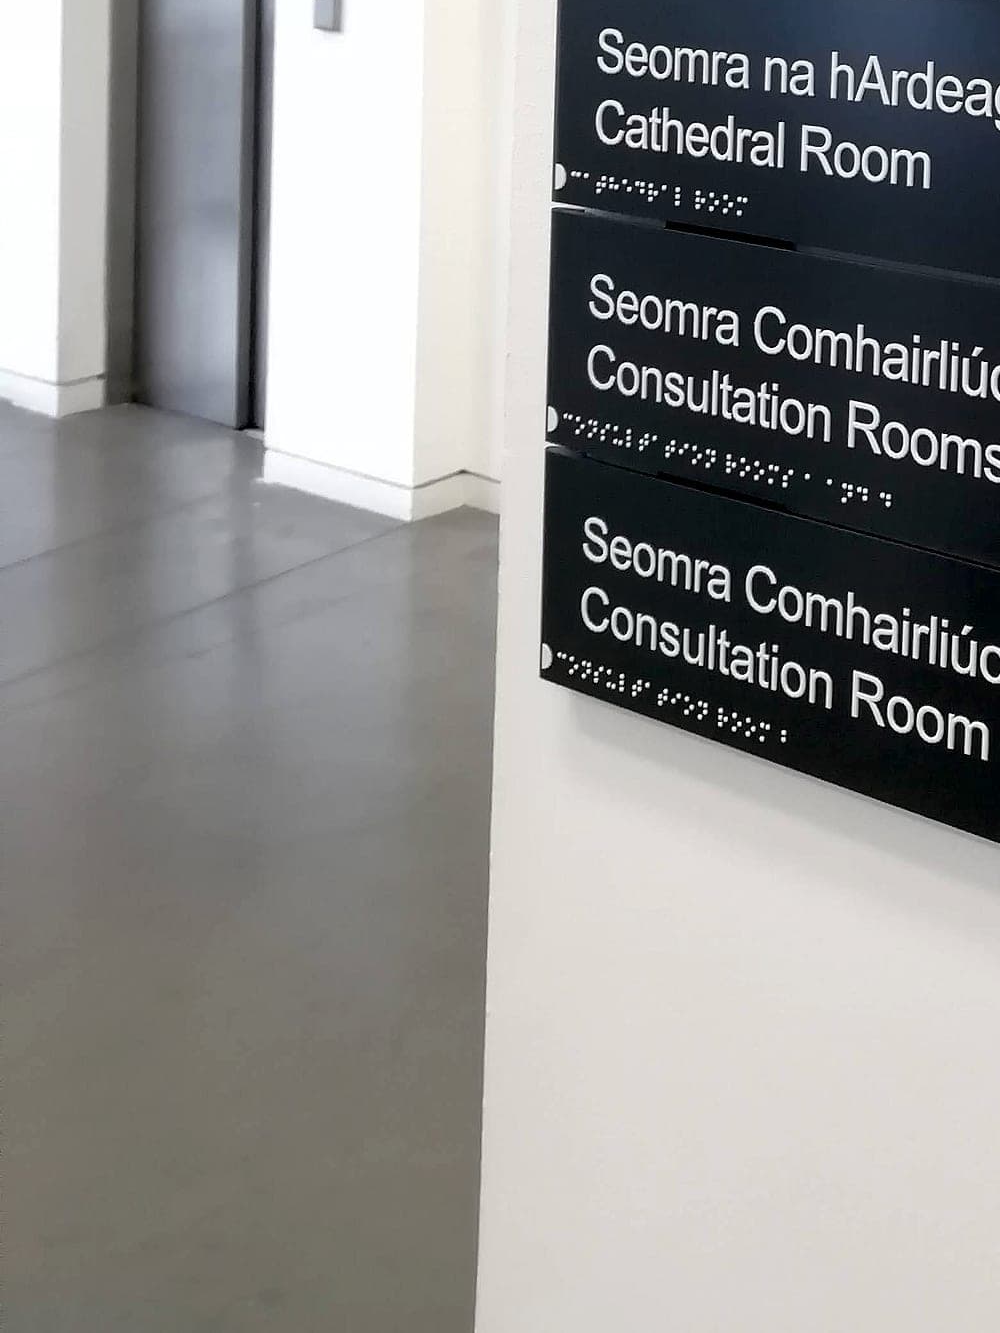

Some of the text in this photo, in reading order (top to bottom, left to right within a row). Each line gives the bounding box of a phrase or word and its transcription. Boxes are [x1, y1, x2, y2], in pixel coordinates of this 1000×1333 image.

[597, 28, 749, 88] Seomra
[764, 57, 815, 96] na
[596, 100, 931, 190] Cathedral Room
[588, 274, 738, 346] Seomra
[586, 345, 831, 442] Consultation
[582, 517, 730, 602] Seomra
[580, 587, 833, 710] Consultation
[851, 669, 989, 761] Room
